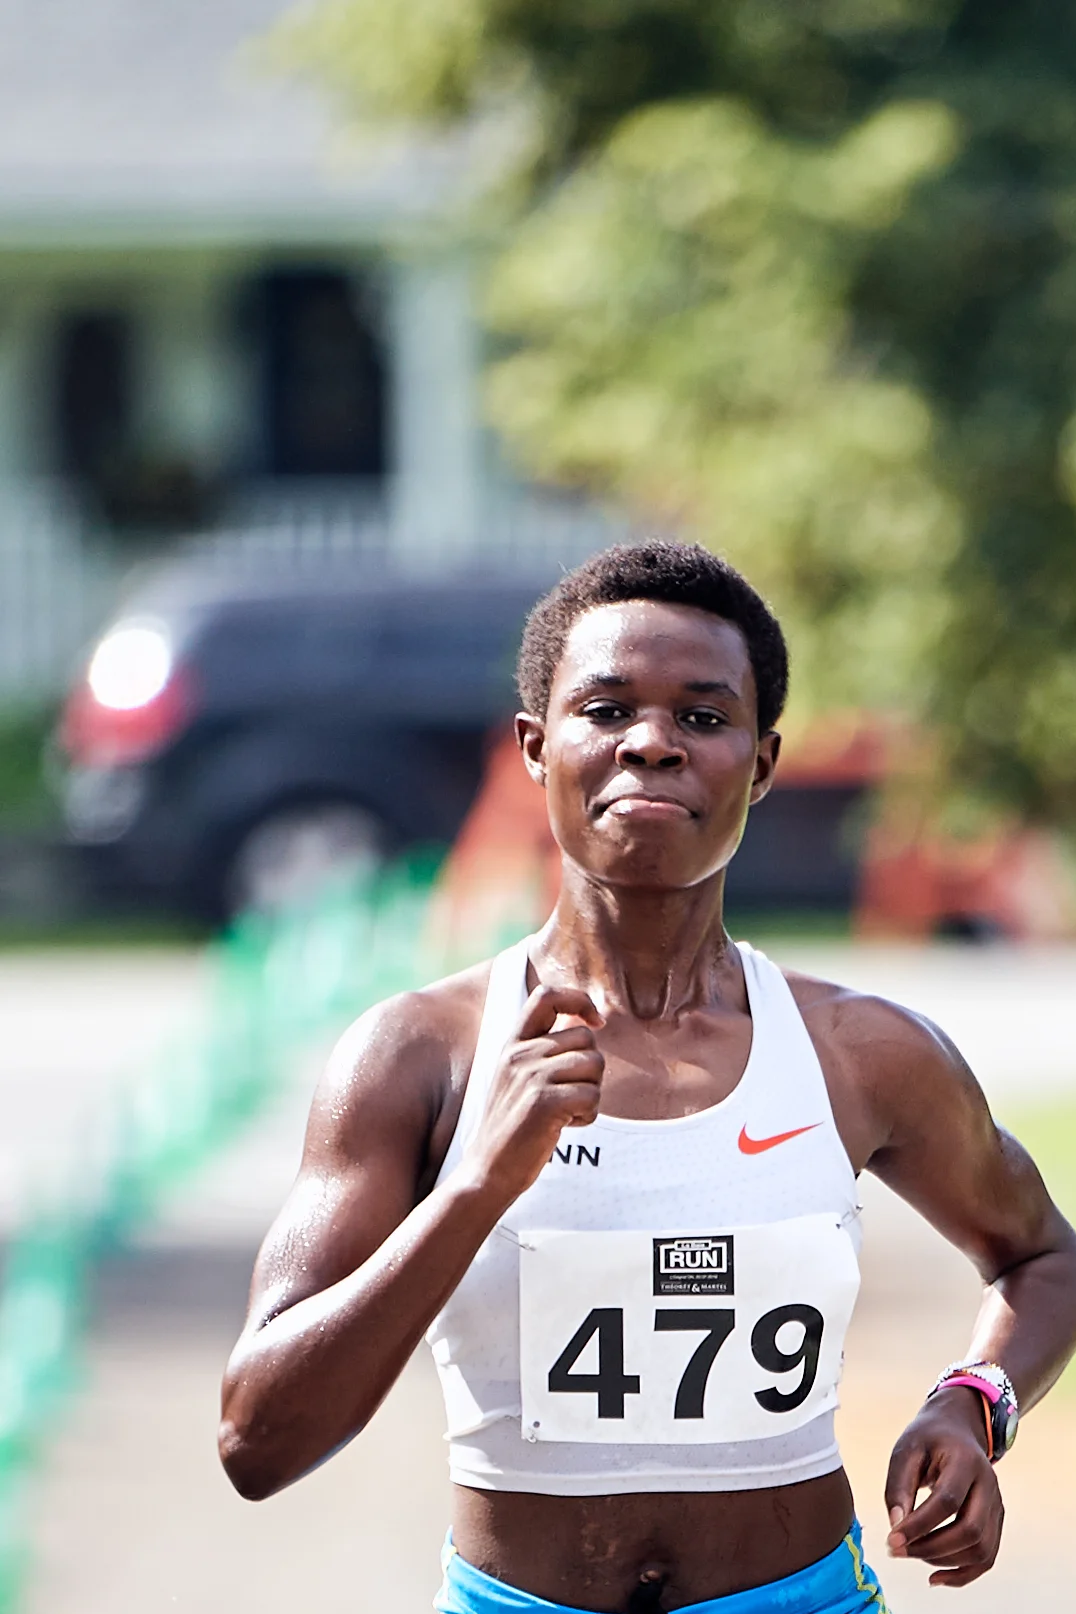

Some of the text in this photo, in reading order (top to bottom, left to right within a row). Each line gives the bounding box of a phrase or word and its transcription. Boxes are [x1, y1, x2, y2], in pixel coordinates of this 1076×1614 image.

[669, 1251, 718, 1268] RUN
[691, 1283, 700, 1292] &
[548, 1304, 824, 1419] 479
